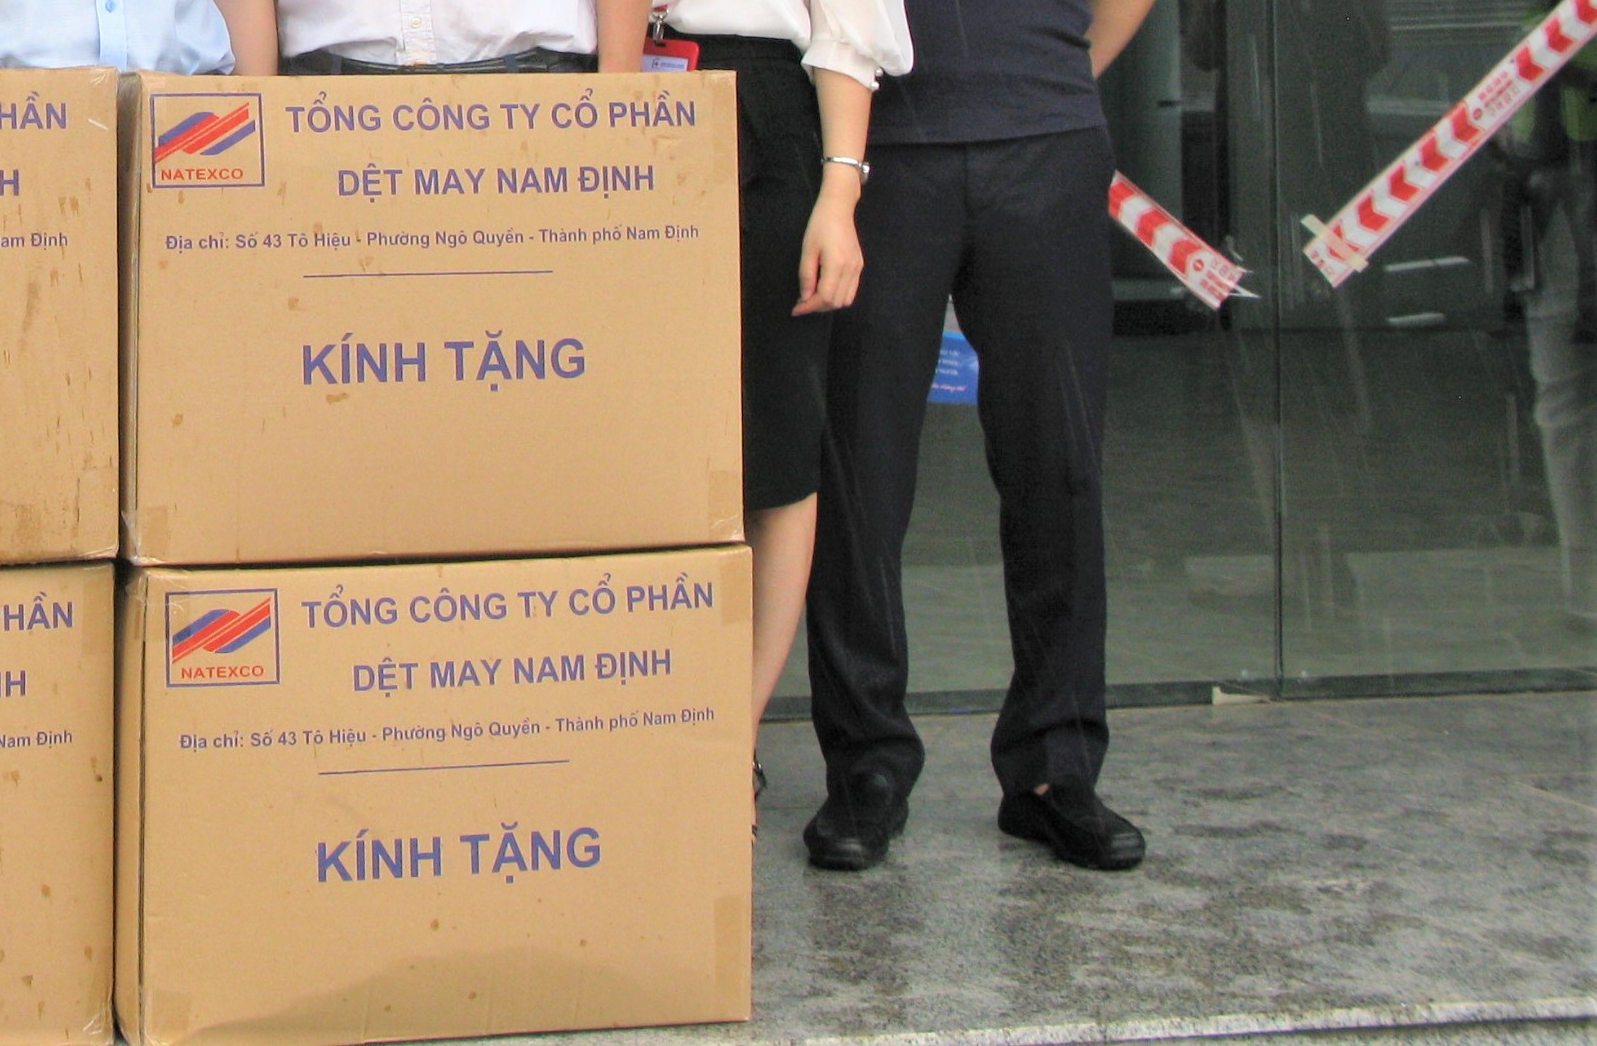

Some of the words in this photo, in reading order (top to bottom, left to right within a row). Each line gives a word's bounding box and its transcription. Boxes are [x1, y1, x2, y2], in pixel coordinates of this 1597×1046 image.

[285, 91, 381, 132] TỔNG
[393, 97, 489, 131] CÔNG
[500, 104, 540, 129] TY
[552, 88, 597, 128] CỔ
[609, 90, 695, 127] PHẦN
[161, 168, 244, 180] NATEXCO
[338, 164, 402, 203] DỆT
[415, 169, 485, 195] MAY
[497, 167, 567, 194] NAM
[578, 165, 653, 199] ĐỊNH
[31, 232, 67, 250] Định
[165, 236, 192, 253] Địa
[236, 234, 257, 248] Số
[263, 234, 281, 248] 43
[287, 233, 308, 247] Tô
[314, 232, 350, 250] Hiệu
[368, 232, 429, 248] Phường
[436, 231, 467, 248] Ngô
[539, 228, 586, 242] Thành
[593, 227, 621, 245] phố
[627, 227, 659, 240] Nam
[665, 225, 698, 242] Định
[303, 333, 425, 385] KÍNH
[444, 330, 584, 391] TẶNG
[302, 584, 397, 628] TỔNG
[410, 588, 506, 623] CÔNG
[518, 591, 557, 618] TY
[569, 573, 615, 615] CỔ
[627, 572, 712, 612] PHẦN
[180, 666, 264, 678] NATEXCO
[354, 657, 418, 697] DỆT
[431, 659, 501, 688] MAY
[514, 655, 584, 684] NAM
[595, 649, 670, 685] ĐỊNH
[37, 730, 72, 748] Định
[180, 734, 207, 752] Địa
[251, 732, 272, 747] Số
[278, 732, 296, 745] 43
[302, 730, 323, 744] Tô
[330, 729, 365, 747] Hiệu
[383, 727, 446, 742] Phường
[452, 722, 483, 741] Ngô
[556, 716, 603, 732] Thành
[610, 713, 638, 732] phố
[644, 712, 675, 725] Nam
[681, 707, 714, 725] Định
[318, 829, 441, 882] KÍNH
[460, 822, 600, 883] TẶNG
